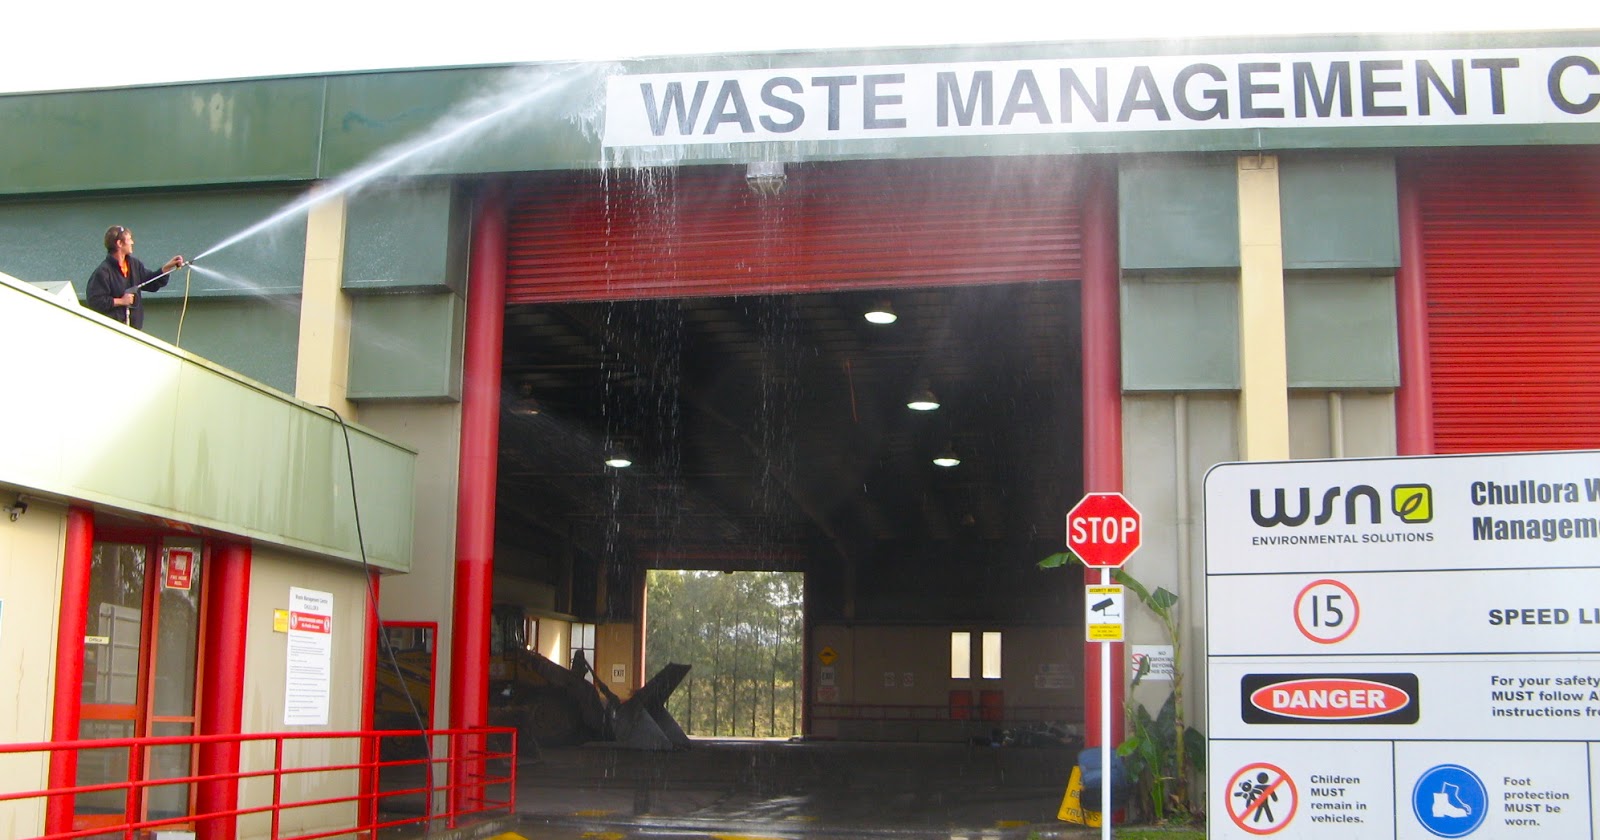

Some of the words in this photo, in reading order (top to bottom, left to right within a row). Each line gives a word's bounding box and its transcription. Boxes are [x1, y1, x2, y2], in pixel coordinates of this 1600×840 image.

[640, 72, 907, 136] WASTE
[936, 57, 1520, 127] MANAGEMENT
[1470, 480, 1580, 506] Chullora
[1071, 516, 1137, 544] STOP
[1472, 516, 1600, 542] Managem
[1252, 534, 1359, 546] ENVIRONMENTAL
[1361, 532, 1434, 544] SOLUTIONS
[1312, 595, 1343, 627] 15
[1488, 608, 1570, 626] SPEED
[613, 669, 624, 677] EXIT
[1491, 675, 1514, 686] For
[1519, 677, 1551, 688] your
[1273, 689, 1386, 709] DANGER
[1492, 691, 1534, 701] MUST
[1539, 691, 1583, 701] follow
[1589, 691, 1600, 701] A
[1492, 706, 1580, 717] instructions
[1310, 775, 1360, 784] Children
[1504, 777, 1531, 786] Foot
[1310, 788, 1345, 797] MUST
[1504, 791, 1570, 801] protection
[1310, 801, 1352, 810] remain
[1356, 801, 1367, 810] in
[1504, 803, 1541, 813] MUST
[1545, 804, 1561, 813] be
[1310, 814, 1364, 823] vehicles.
[1504, 818, 1540, 826] worn.
